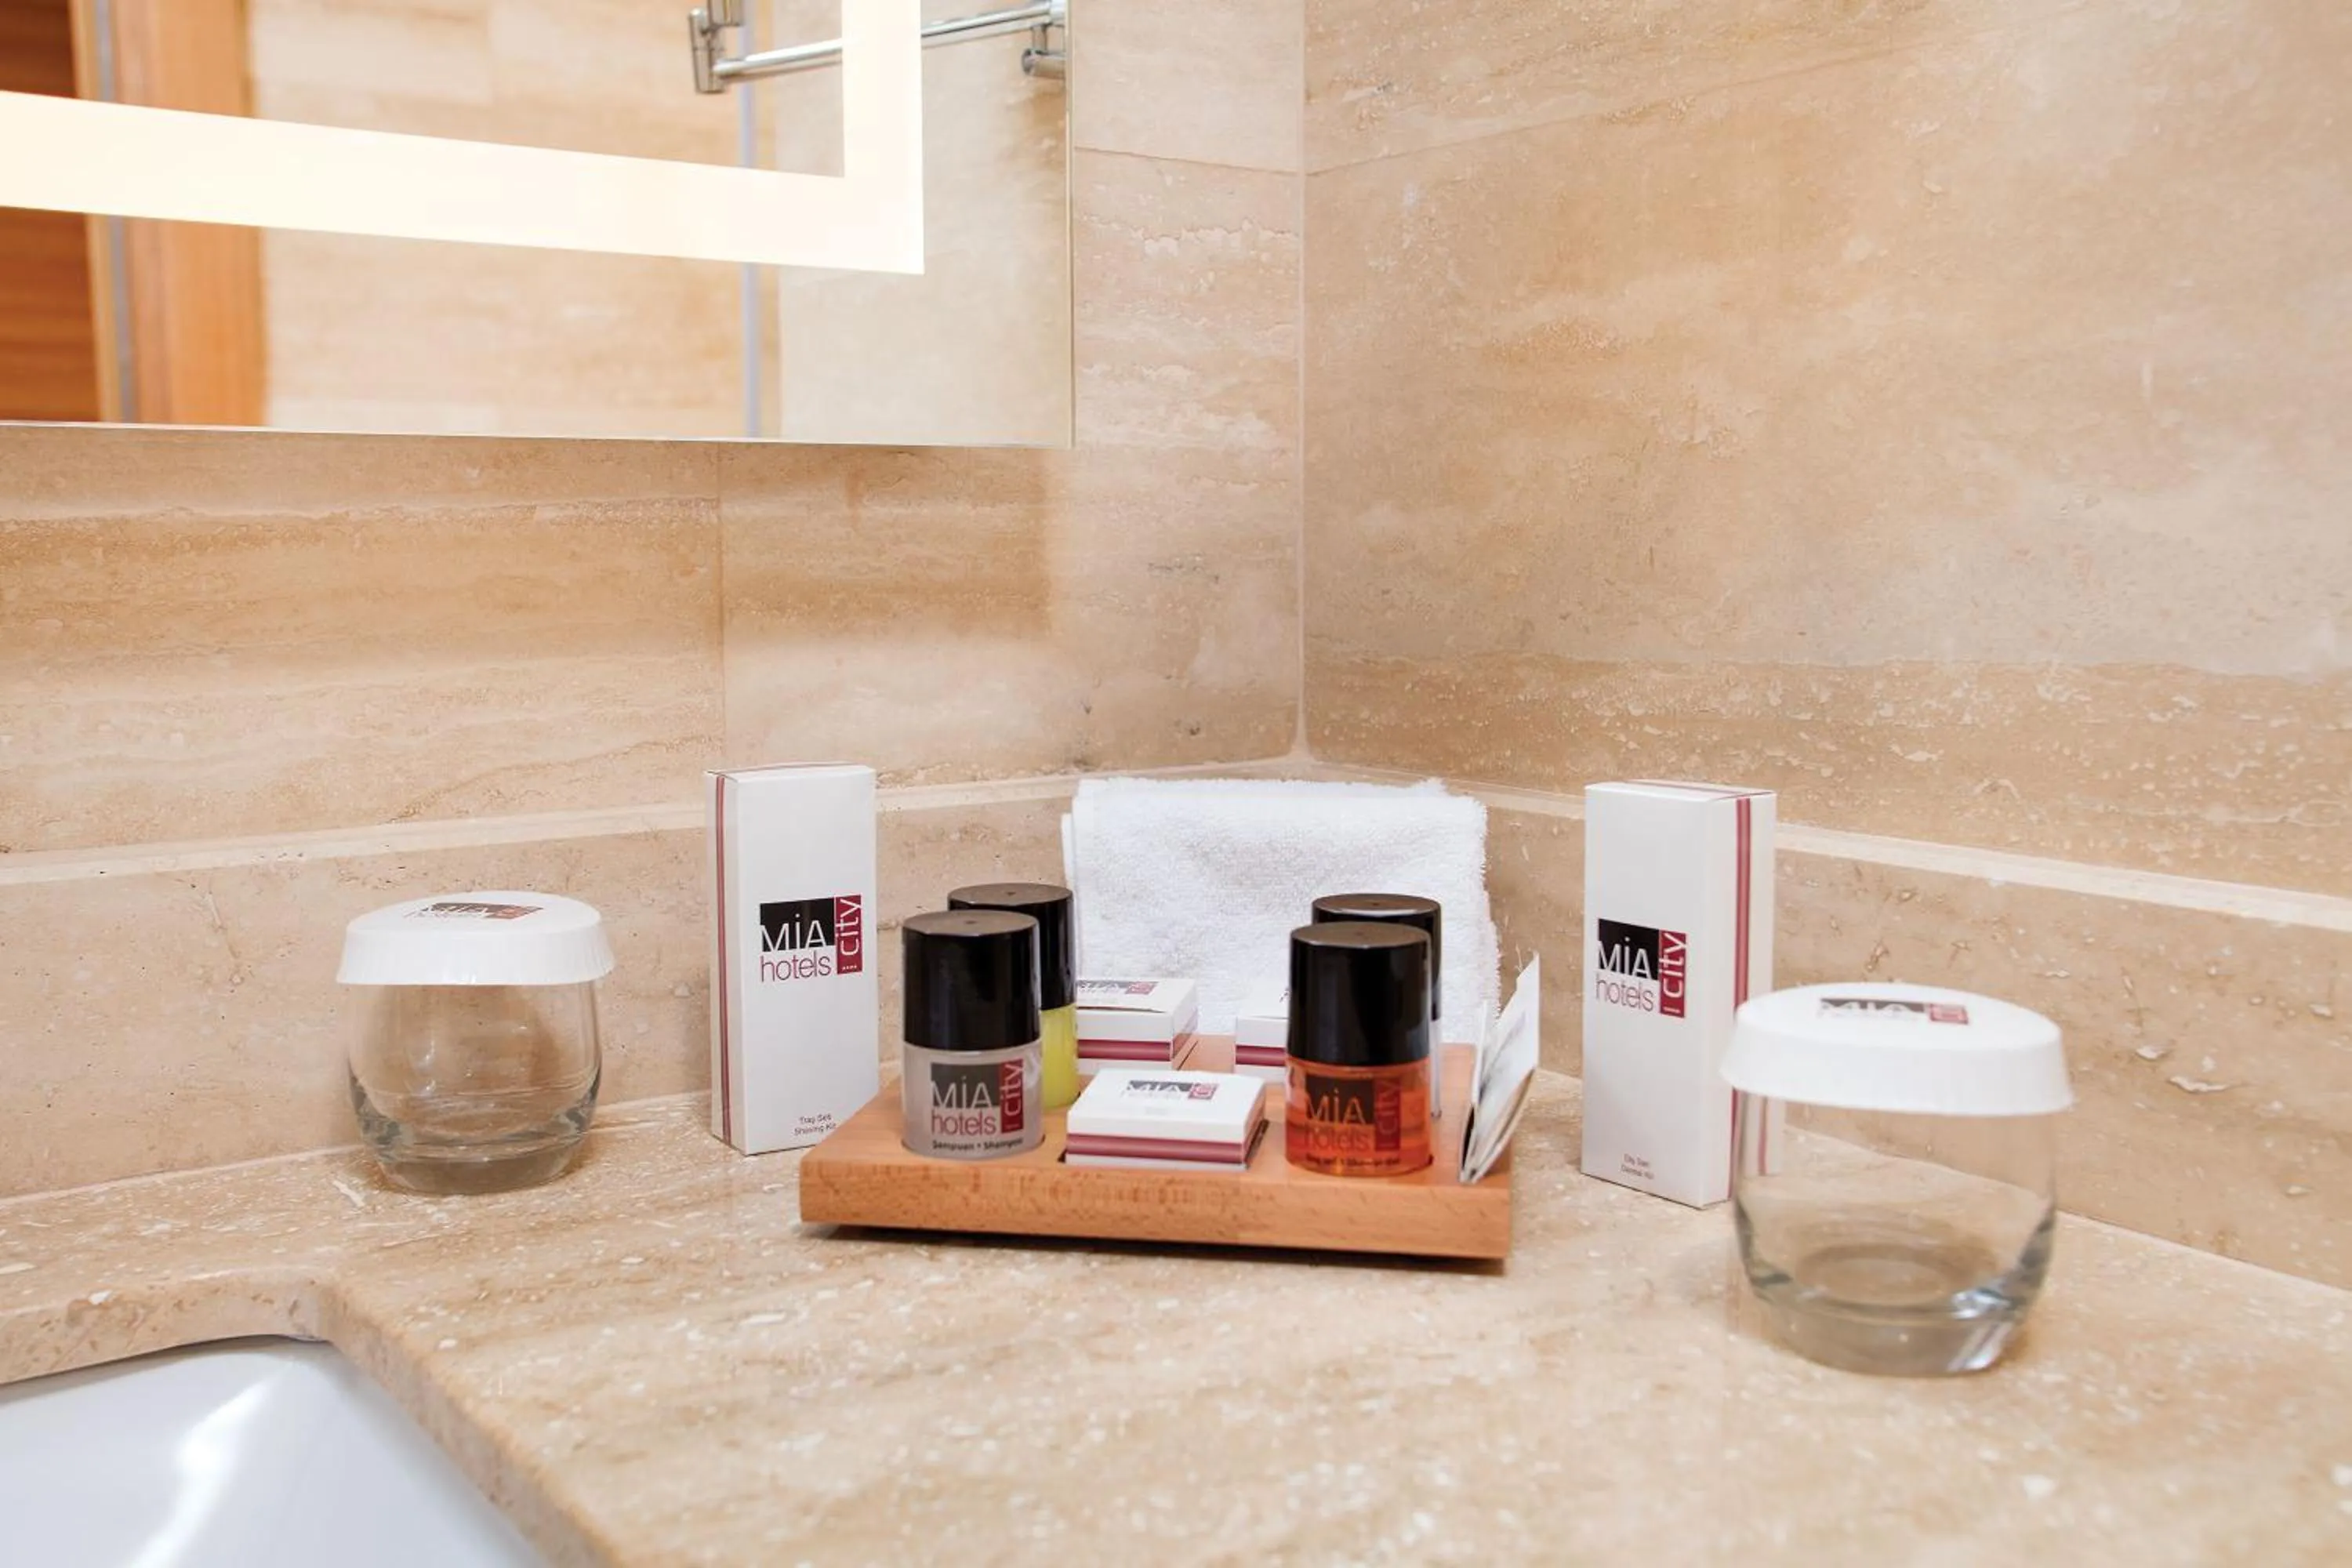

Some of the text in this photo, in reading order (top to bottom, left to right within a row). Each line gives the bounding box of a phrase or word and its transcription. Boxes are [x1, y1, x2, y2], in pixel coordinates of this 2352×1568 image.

[760, 950, 832, 983] hotels
[1596, 972, 1654, 1012] hotels
[931, 1109, 996, 1136] hotels
